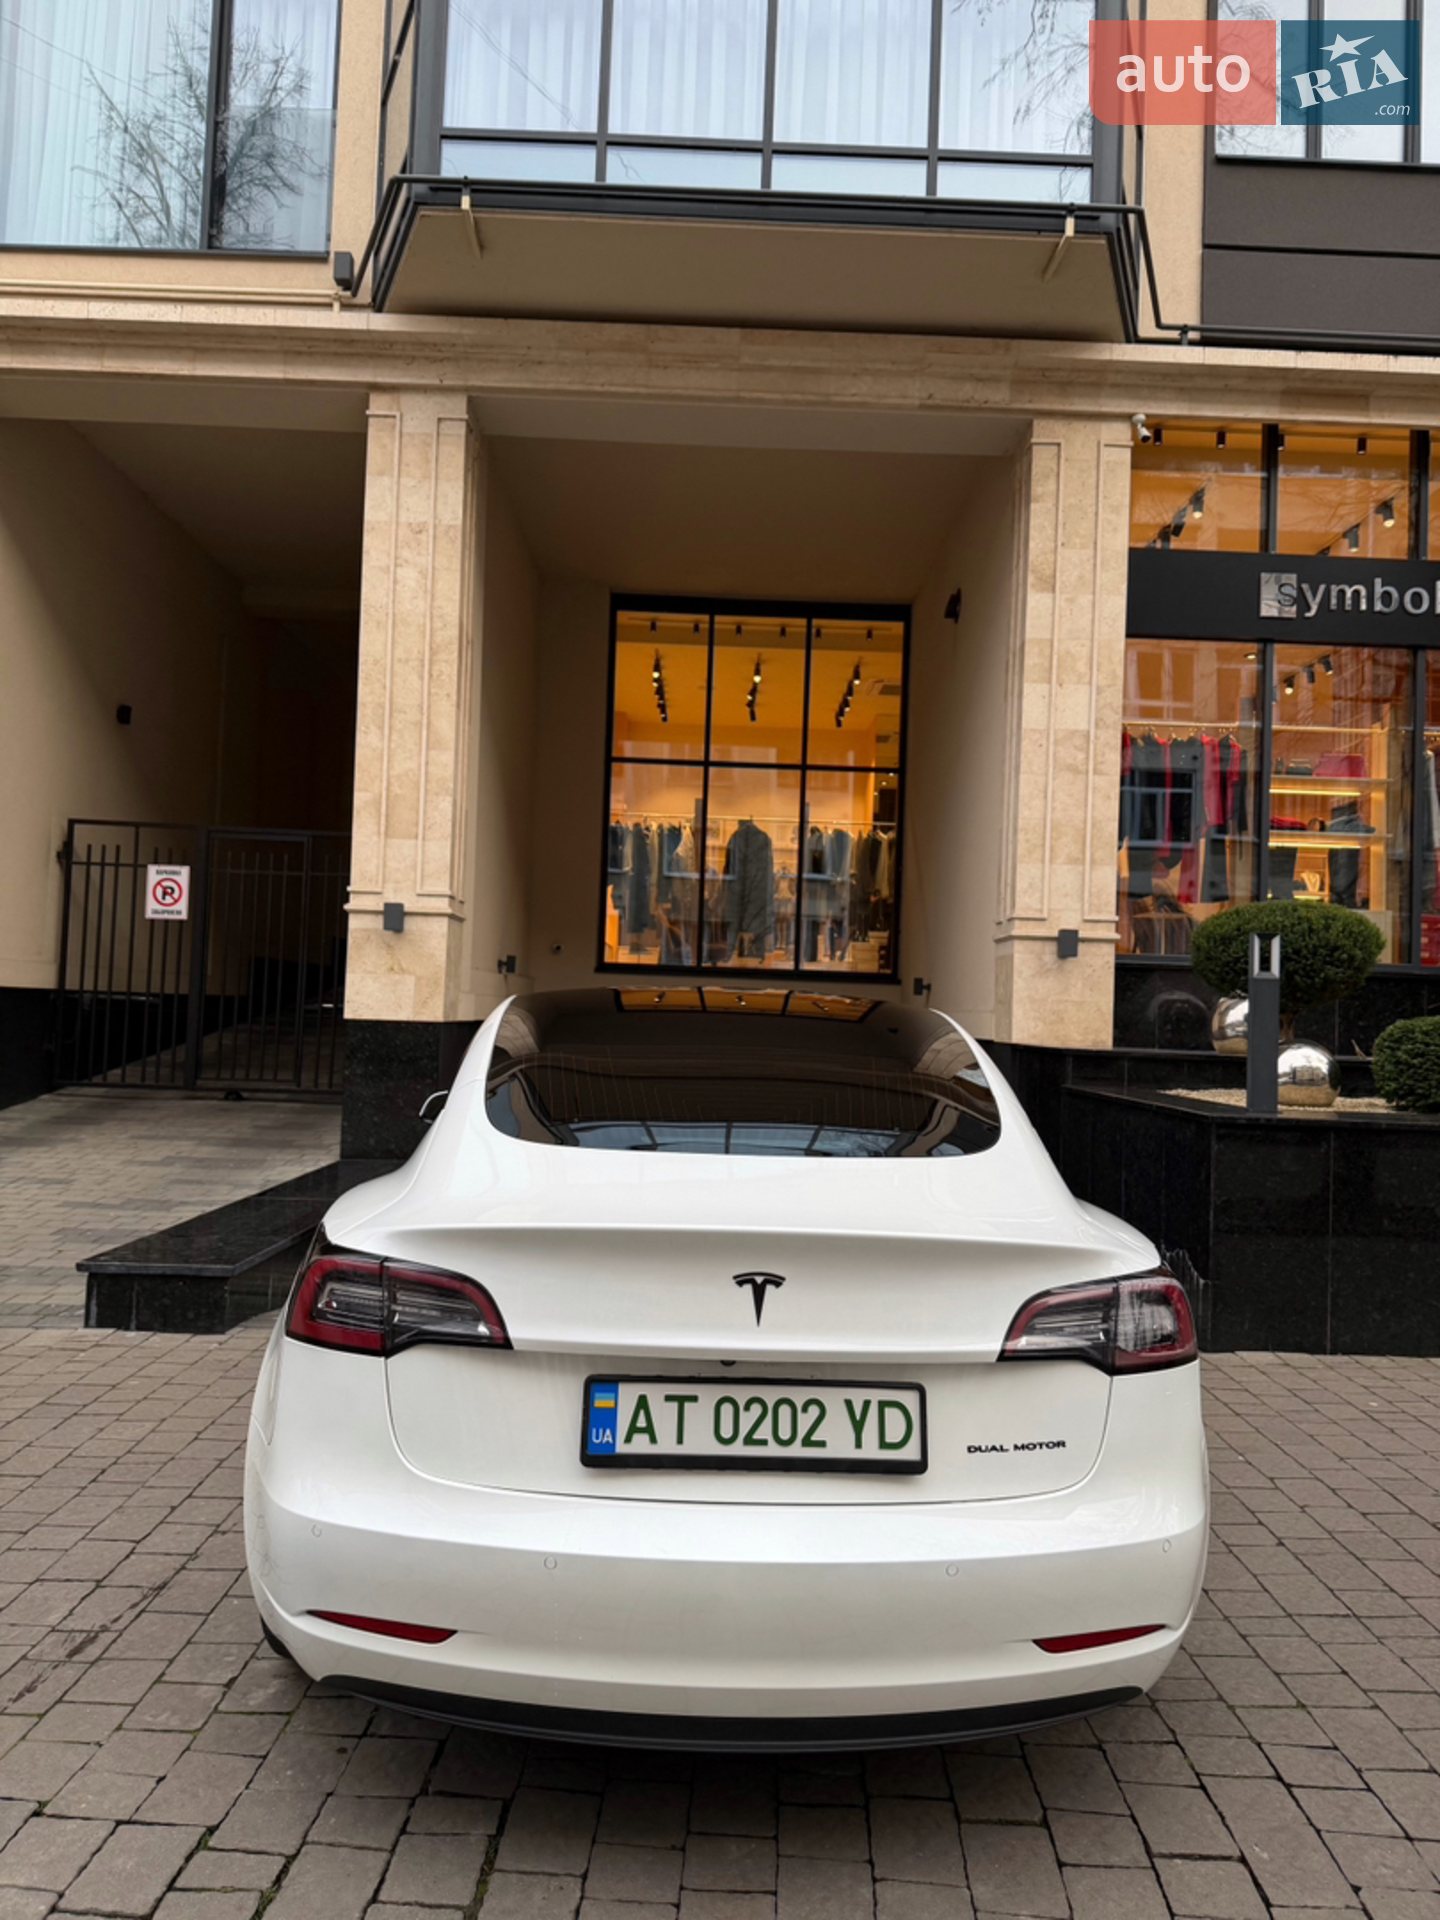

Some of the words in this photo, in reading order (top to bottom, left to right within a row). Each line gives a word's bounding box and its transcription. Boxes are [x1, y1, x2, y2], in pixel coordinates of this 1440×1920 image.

[624, 1394, 698, 1445] AT
[713, 1396, 827, 1448] 0202
[844, 1399, 913, 1450] YD
[592, 1427, 613, 1444] UA
[967, 1444, 1009, 1454] DUAL
[1013, 1440, 1066, 1451] MOTOR
